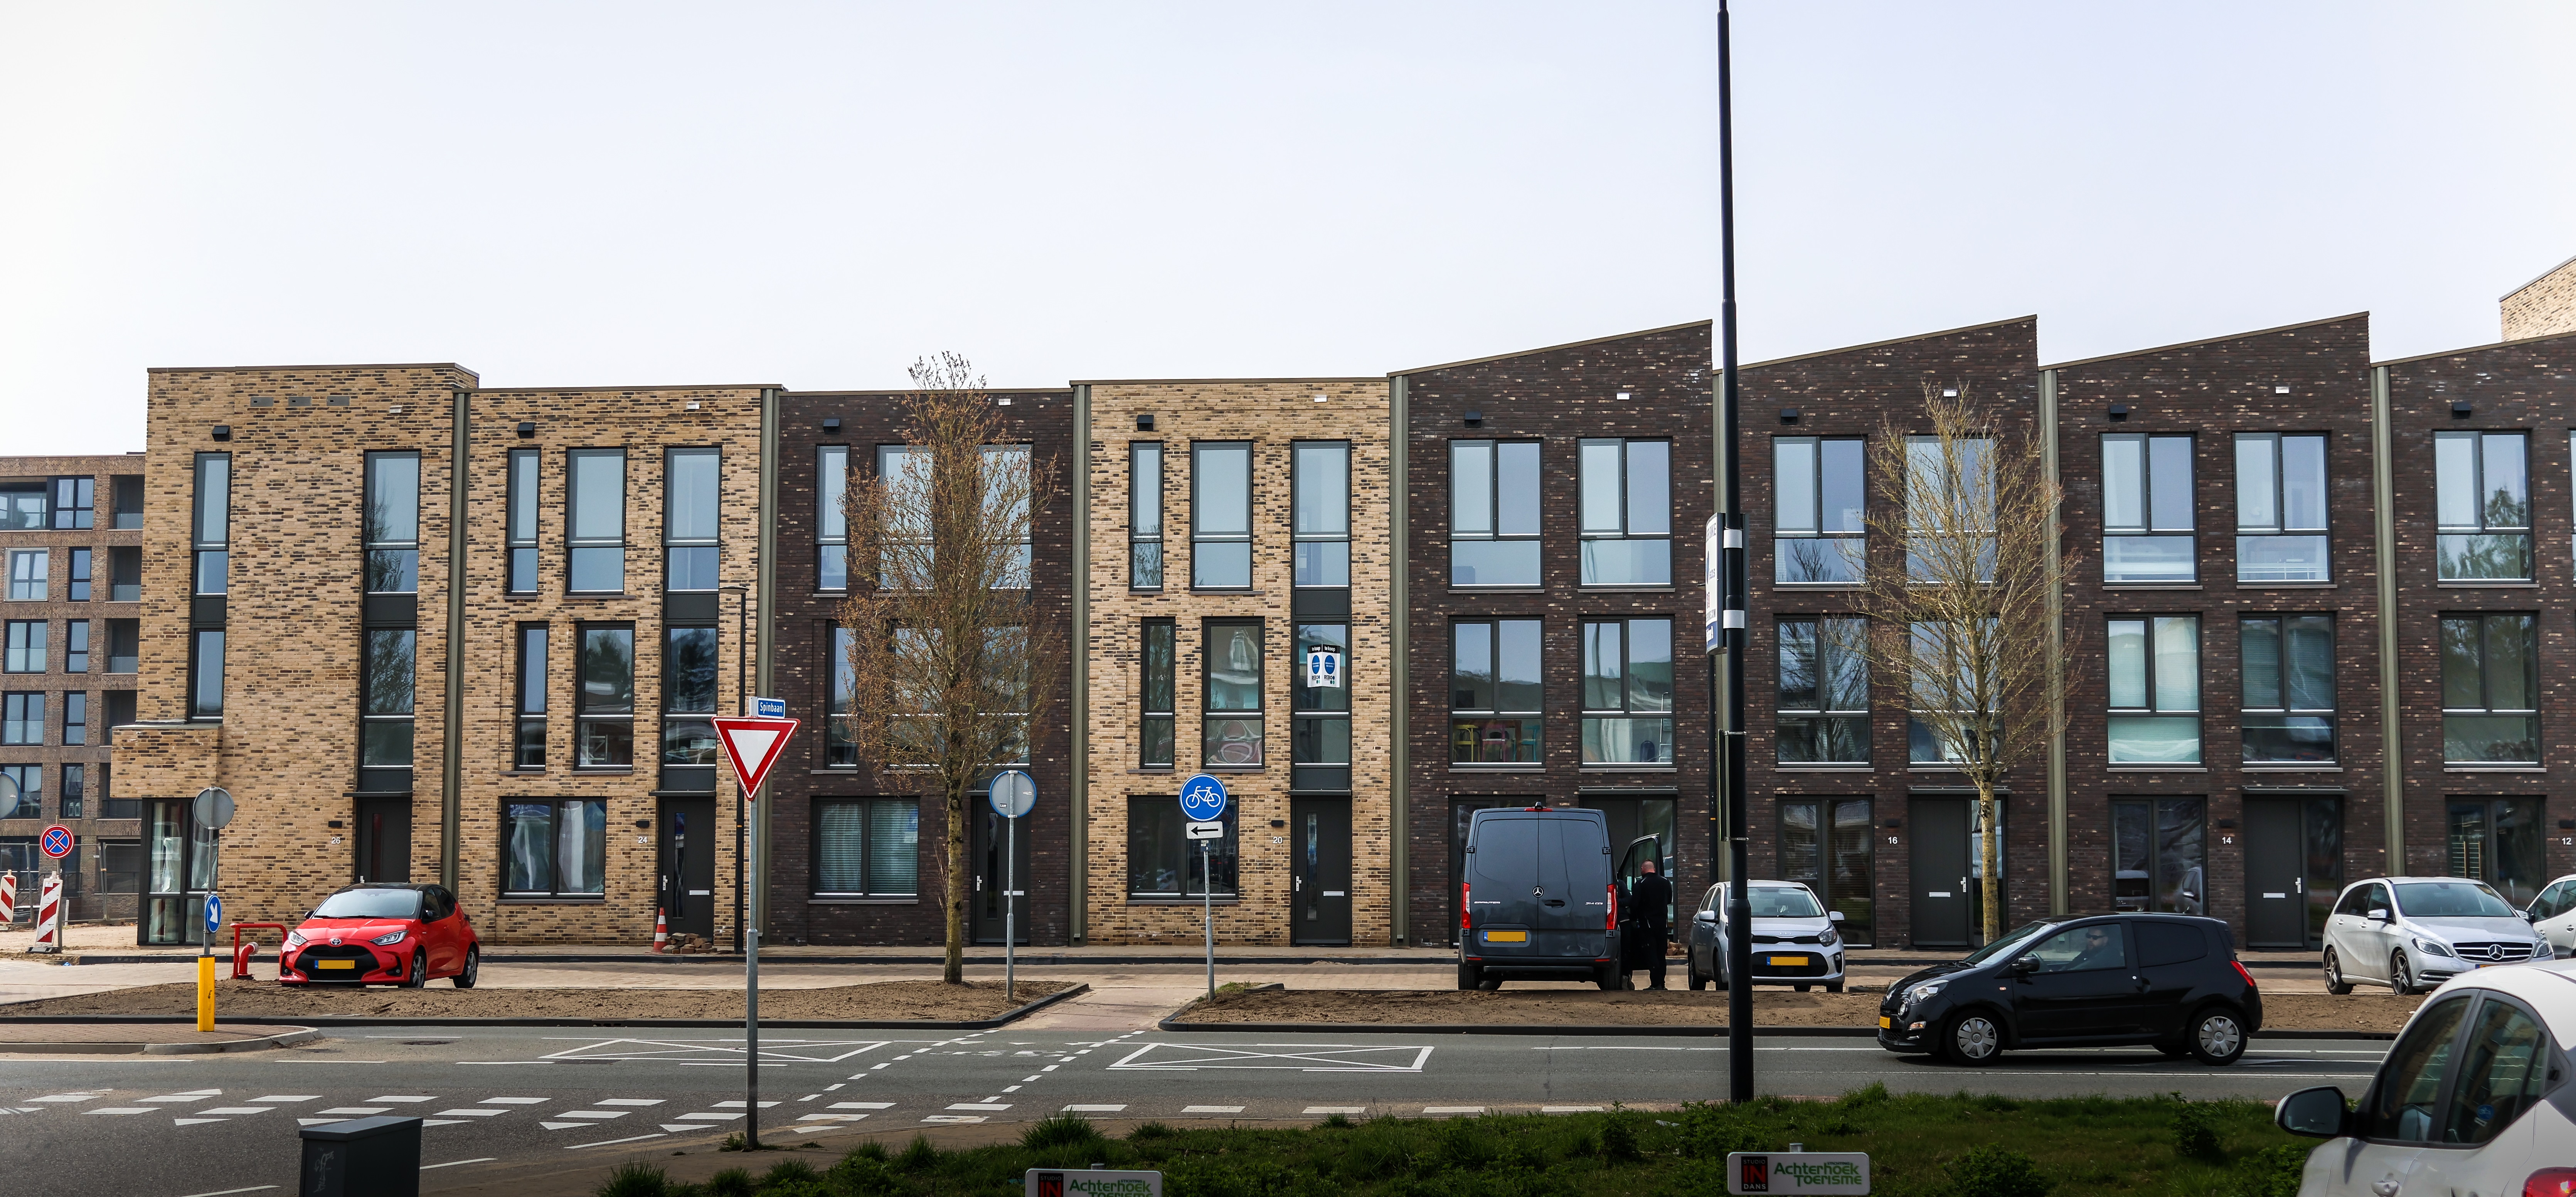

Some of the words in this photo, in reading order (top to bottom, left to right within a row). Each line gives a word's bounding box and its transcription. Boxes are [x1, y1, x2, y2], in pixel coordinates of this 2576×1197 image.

[760, 702, 782, 714] Spinbaan
[1744, 1165, 1765, 1183] IN
[1774, 1162, 1859, 1175] Achterhoek
[1040, 1182, 1061, 1197] IN
[1069, 1179, 1151, 1192] Achterhoek
